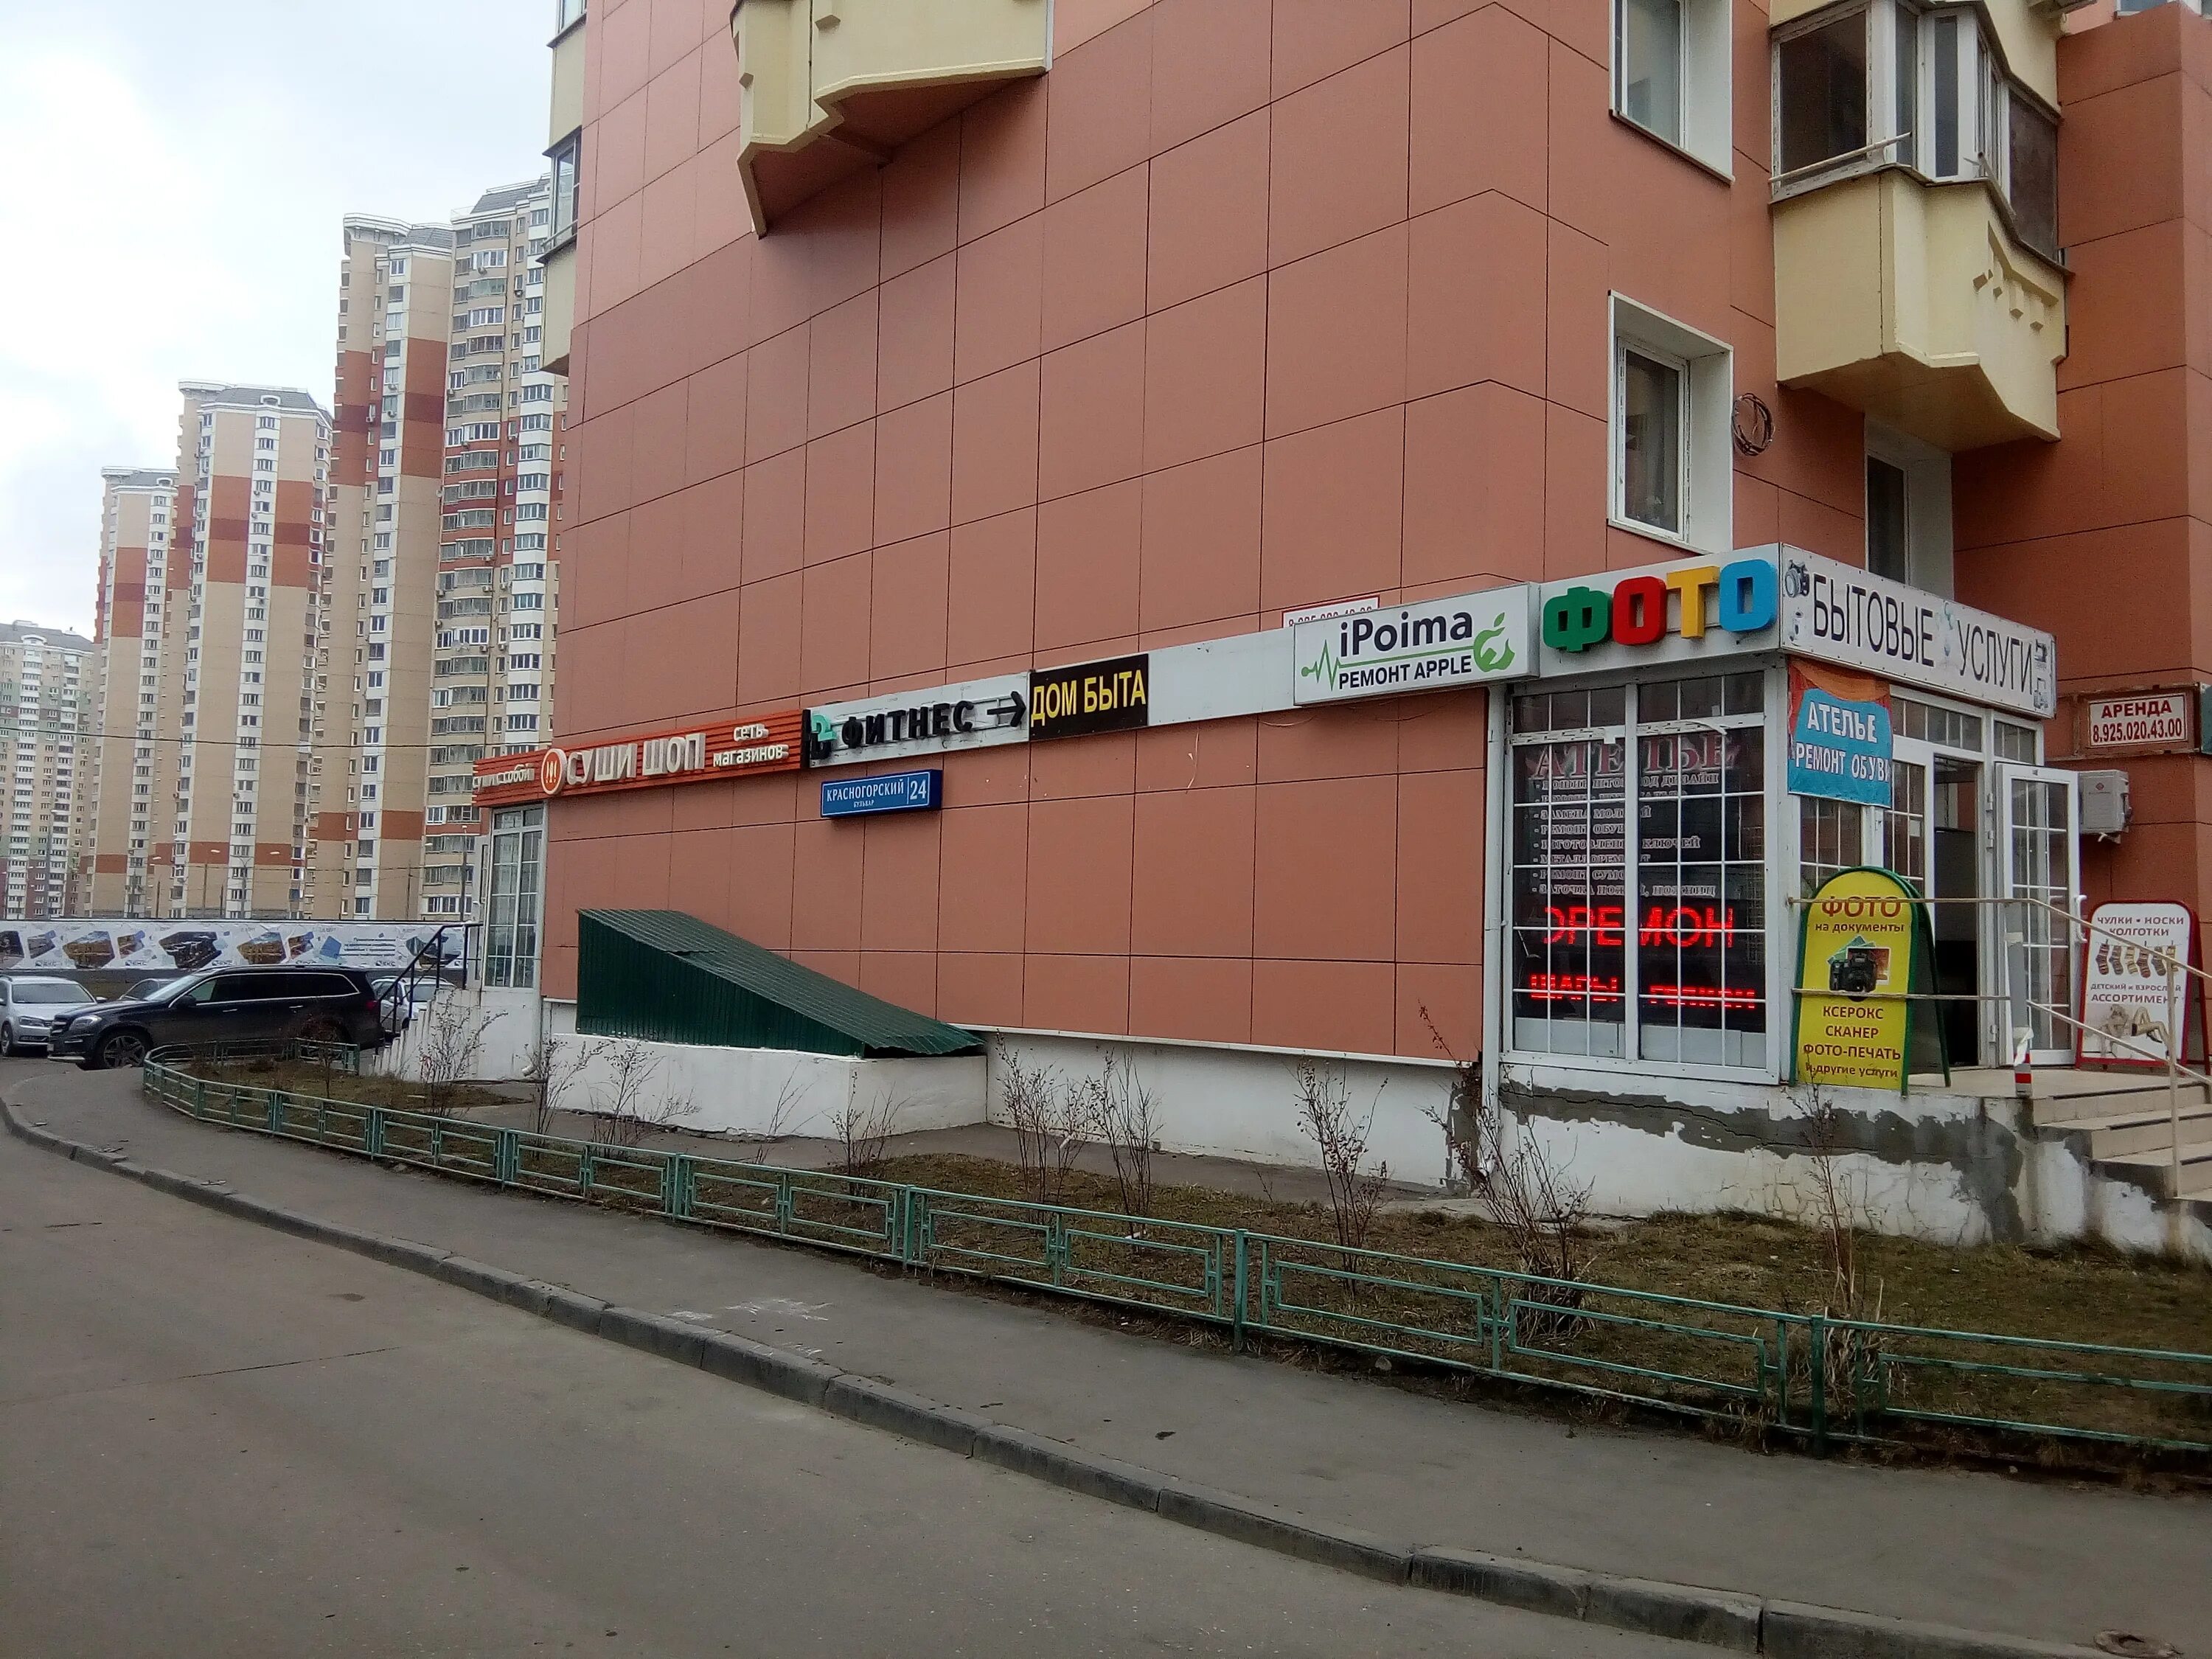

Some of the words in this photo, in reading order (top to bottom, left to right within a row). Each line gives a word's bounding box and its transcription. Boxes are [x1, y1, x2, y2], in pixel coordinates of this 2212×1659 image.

[1543, 559, 1778, 653] ФОТО
[1340, 611, 1473, 657] iPoima
[1812, 572, 1934, 667] БЫТОВЫЕ
[1956, 620, 2033, 695] УСЛУГИ
[1338, 664, 1411, 689] РЕМОНТ
[1413, 654, 1472, 680] APPLE
[1031, 680, 1078, 728] ДОМ
[1084, 669, 1147, 714] БЫТА
[2101, 700, 2172, 719] АРЕНДА
[733, 723, 769, 742] сеть
[841, 700, 975, 748] ФИТНЕС
[1807, 701, 1878, 743] АТЕЛЬЕ
[2093, 718, 2183, 743] 8.925.020.43.00
[567, 742, 639, 785] СУШИ
[642, 732, 706, 776] ШОП
[713, 743, 789, 768] магазинов
[1795, 742, 1846, 775] РЕМОНТ
[827, 779, 904, 801] КРАСНОГОРСКИЙ
[910, 779, 927, 800] 24
[853, 799, 874, 808] БУЛЬВАР
[1821, 896, 1902, 918] ФОТО
[1815, 924, 1829, 932] на
[1832, 923, 1905, 933] документы
[2097, 917, 2132, 925] ЧУЛКИ
[2144, 917, 2184, 925] НОСКИ
[2090, 983, 2126, 991] ДЕТСКИЙ
[1823, 1006, 1884, 1020] КСЕРОКС
[1826, 1025, 1879, 1039] СКАНЕР
[1804, 1044, 1901, 1060] ФОТО-ПЕЧАТЬ
[1816, 1064, 1856, 1075] другие
[1859, 1067, 1898, 1079] услуги
